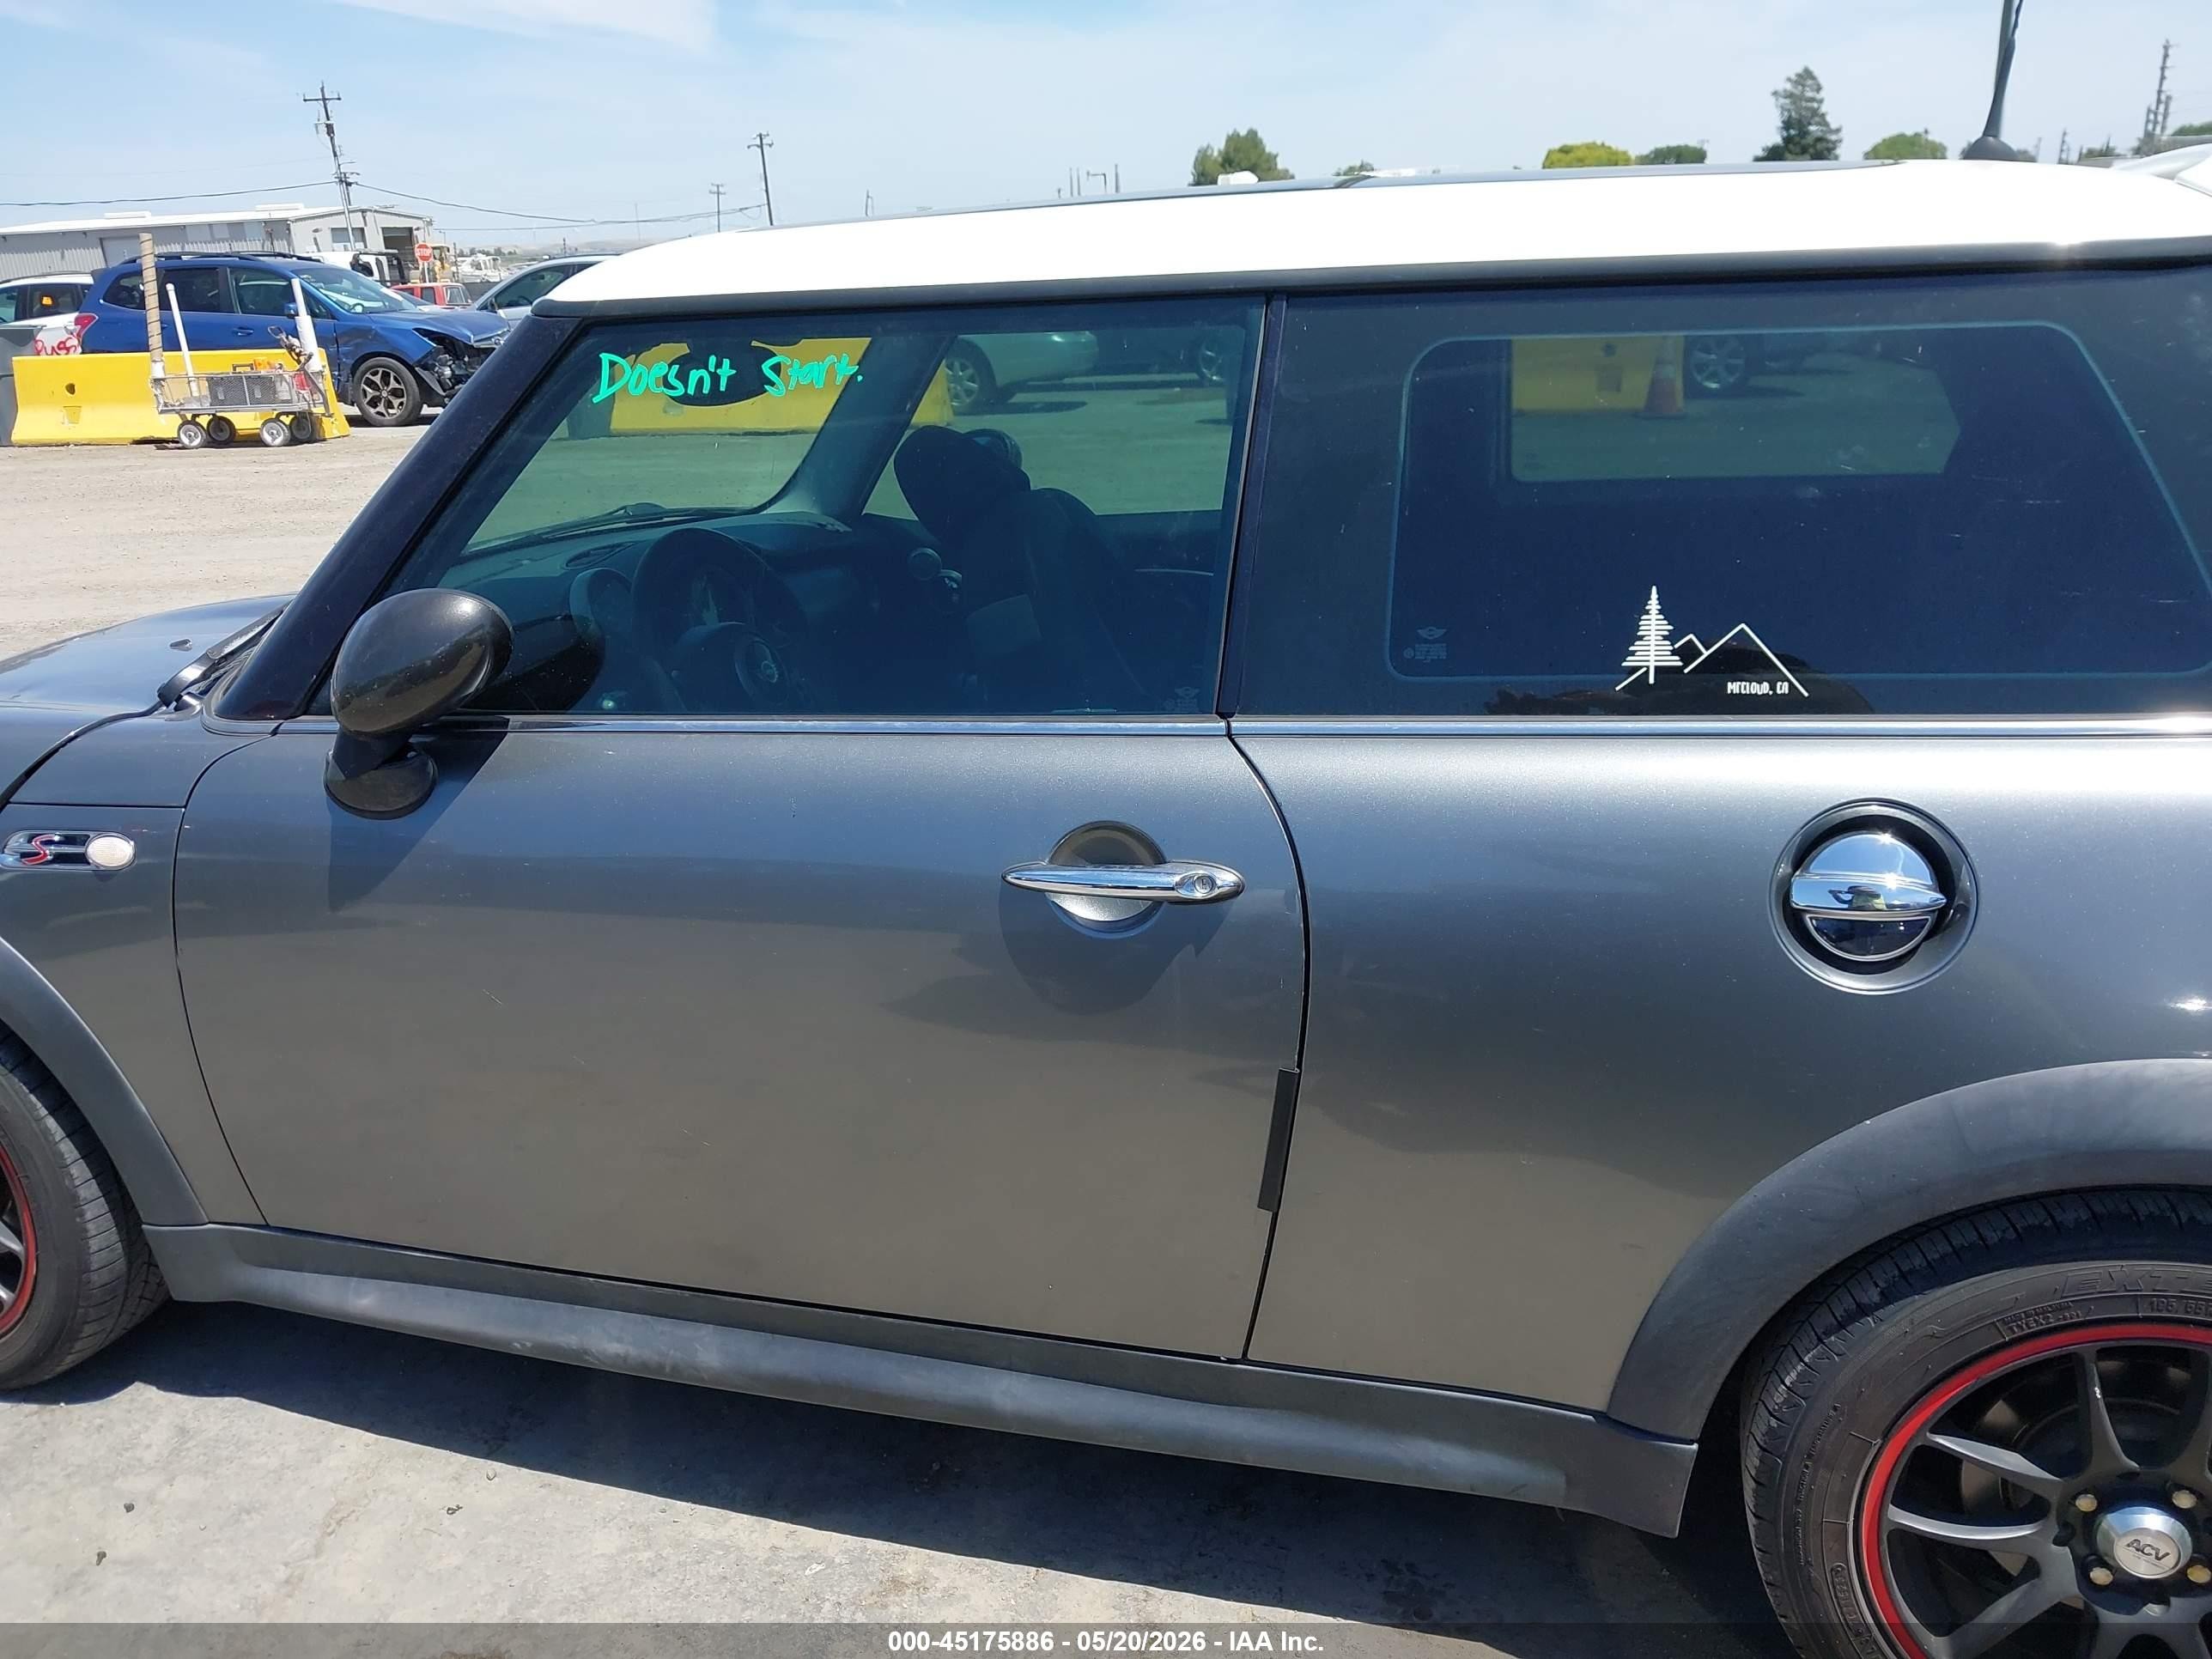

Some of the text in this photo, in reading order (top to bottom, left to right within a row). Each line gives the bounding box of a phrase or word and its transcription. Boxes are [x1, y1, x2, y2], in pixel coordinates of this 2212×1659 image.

[415, 247, 433, 257] STOP
[592, 353, 737, 403] Doesn't
[1776, 681, 1790, 695] CA
[2124, 1538, 2172, 1561] ACV
